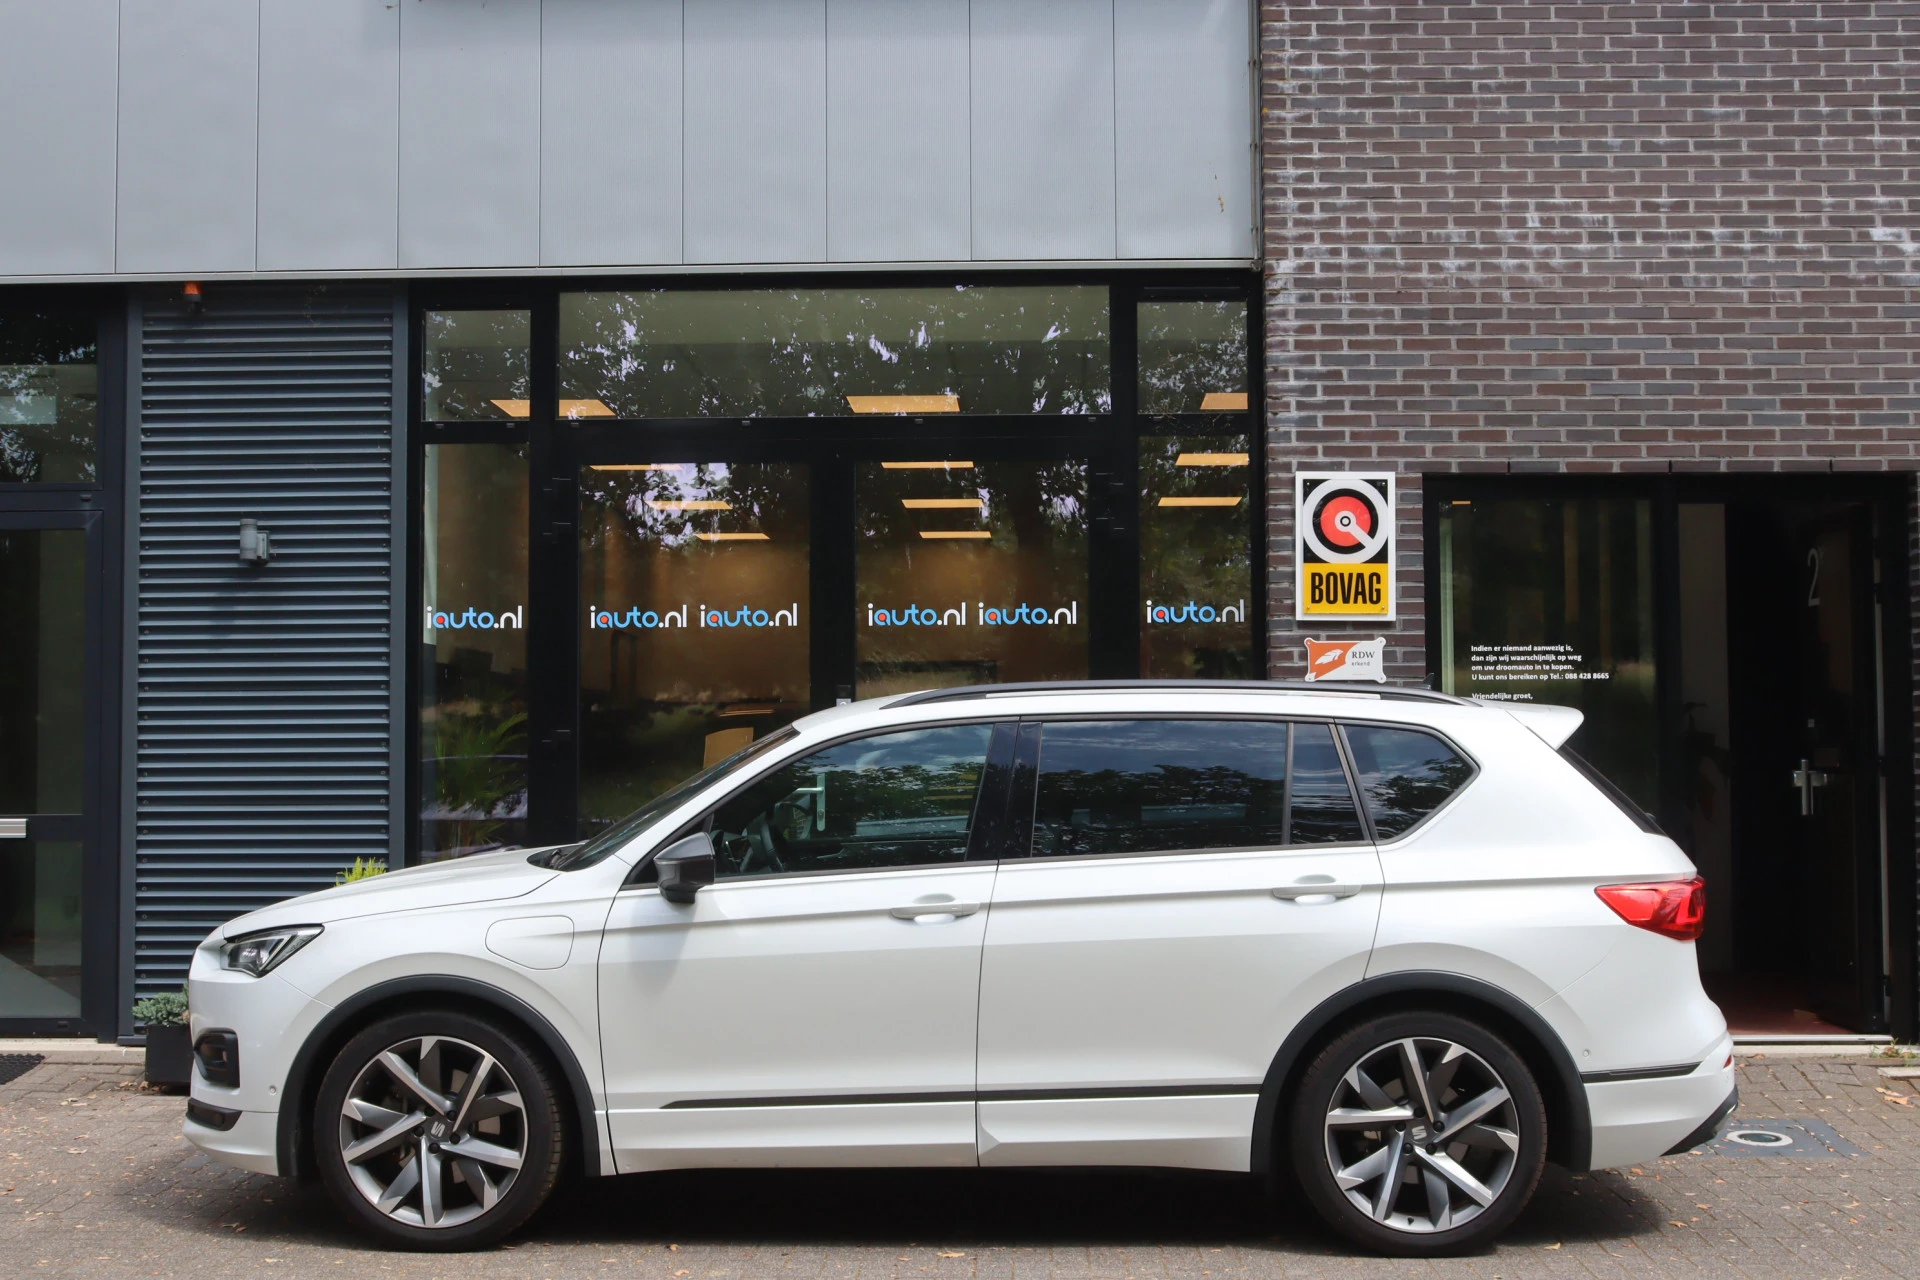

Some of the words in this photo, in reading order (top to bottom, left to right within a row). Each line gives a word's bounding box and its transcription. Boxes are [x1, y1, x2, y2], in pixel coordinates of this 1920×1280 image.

[1311, 572, 1382, 604] BOVAG
[426, 605, 523, 629] iauto.nl
[590, 604, 687, 628] iauto.nl
[700, 603, 798, 628] iauto.nl
[867, 602, 966, 627] iauto.nl
[978, 601, 1077, 626] iauto.nl
[1146, 599, 1245, 624] iauto.nl
[1352, 651, 1375, 659] RDW
[1498, 654, 1509, 662] wij
[1510, 654, 1556, 662] waarschijnlijk
